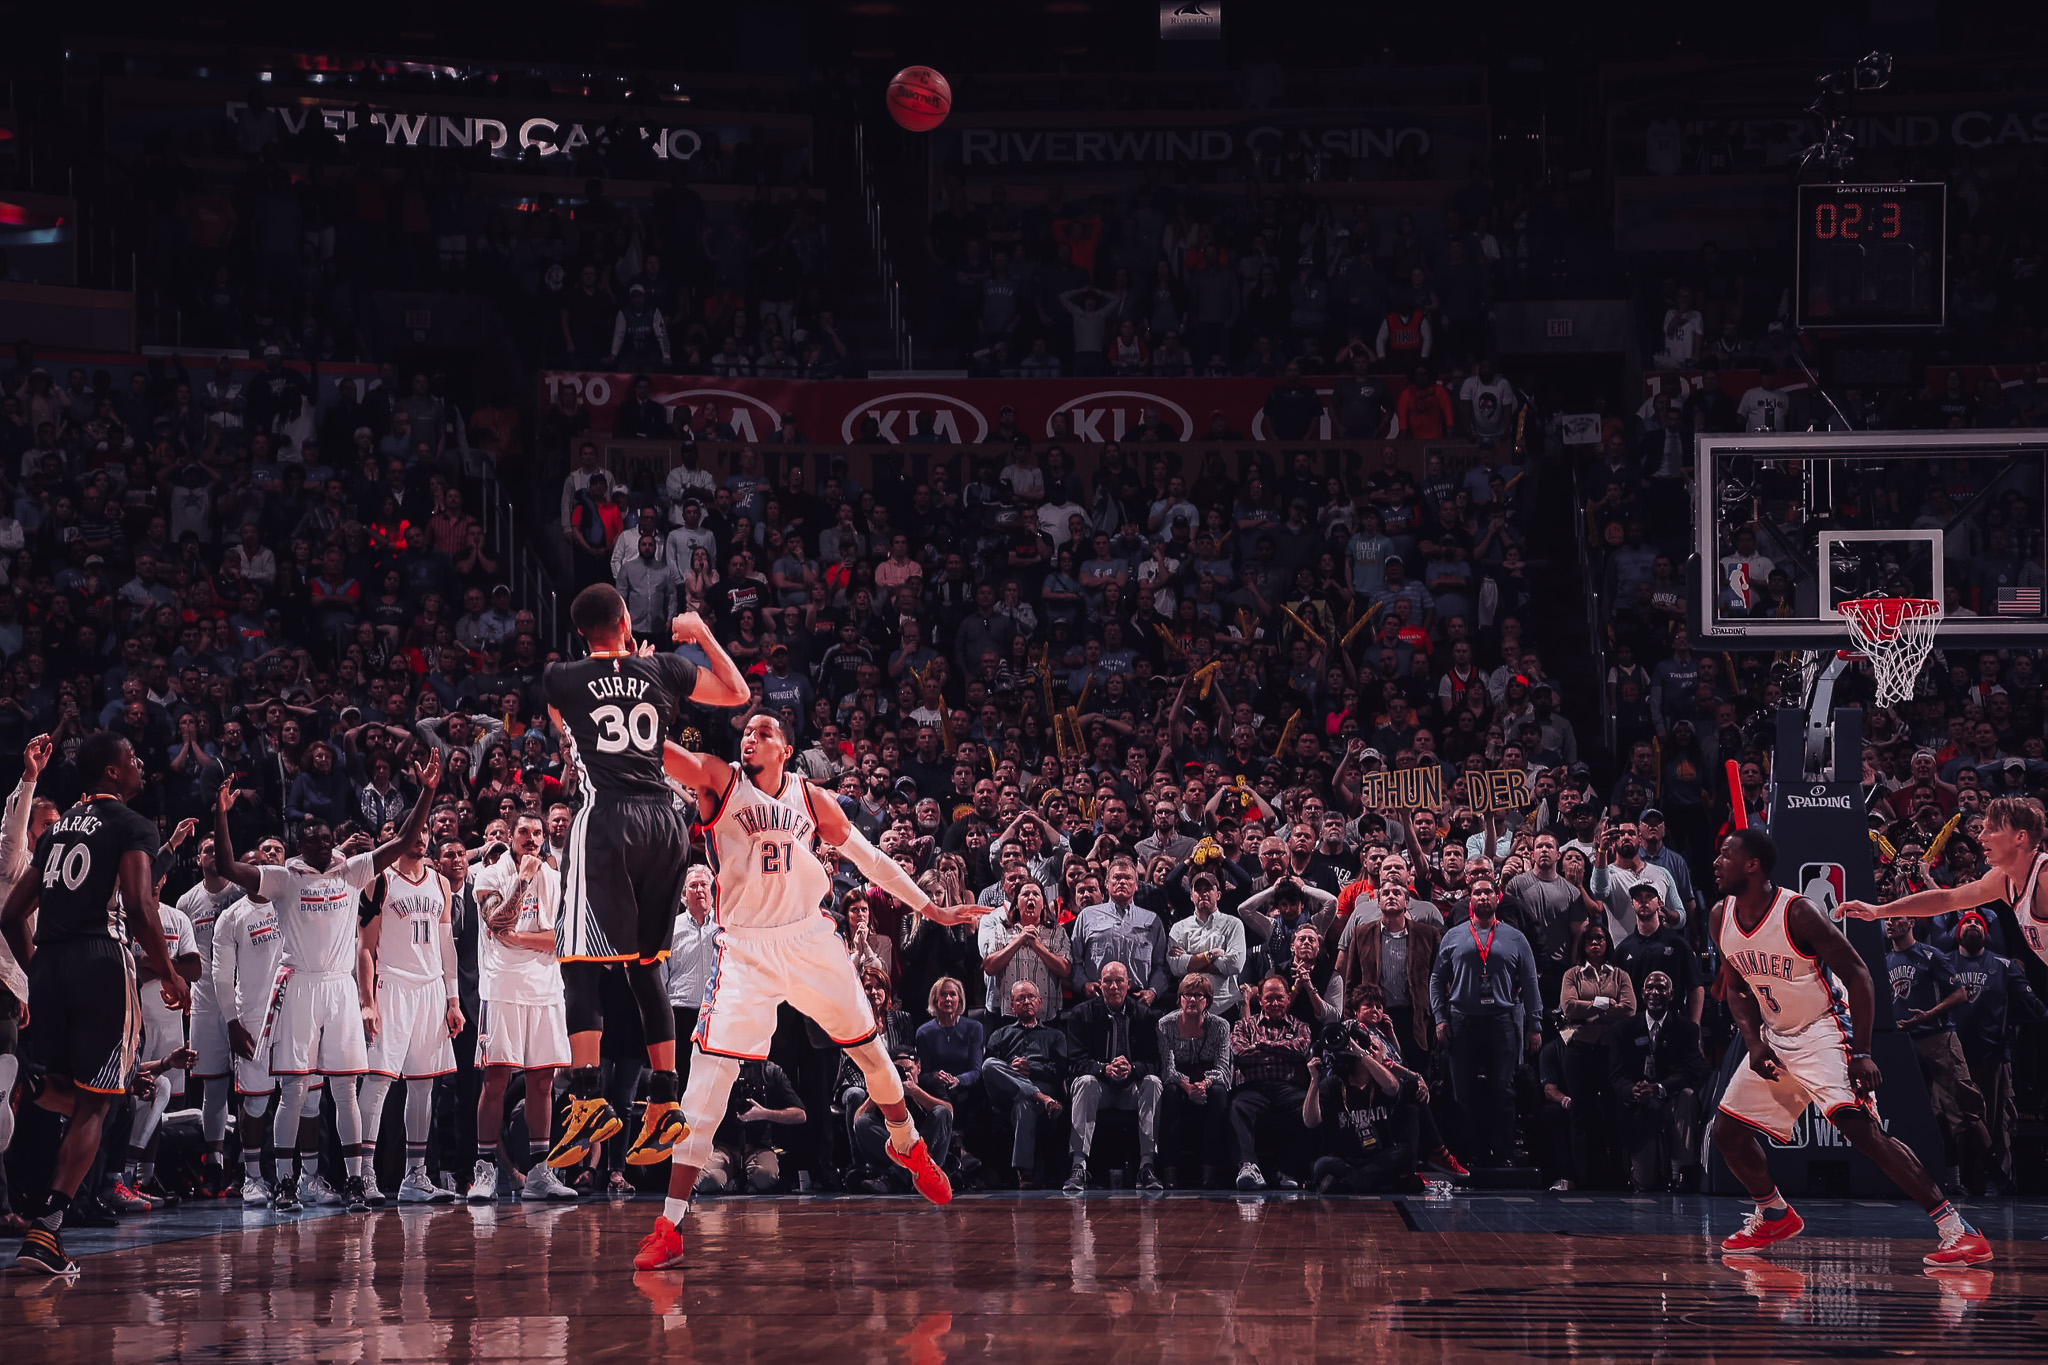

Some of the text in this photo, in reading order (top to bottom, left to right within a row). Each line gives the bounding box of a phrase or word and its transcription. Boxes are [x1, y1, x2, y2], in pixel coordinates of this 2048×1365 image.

[961, 129, 1233, 165] RIVERWIND
[1551, 320, 1569, 335] EXIT
[866, 410, 962, 444] KIA
[1071, 408, 1146, 443] KI
[1711, 627, 1746, 635] SPALDING
[587, 676, 650, 700] CURRY
[769, 690, 794, 700] THUNDER
[589, 702, 659, 754] 30
[1363, 765, 1531, 815] THUN DER
[1787, 795, 1852, 809] SPALDING
[52, 816, 102, 836] BARNES
[732, 804, 810, 841] THUNDER
[42, 842, 92, 891] 40
[761, 841, 794, 874] 21
[300, 902, 348, 912] BASKETBALL
[389, 895, 443, 919] THUNDER
[411, 918, 431, 944] 11
[1727, 950, 1794, 981] HUNDER
[1756, 984, 1781, 1013] 3
